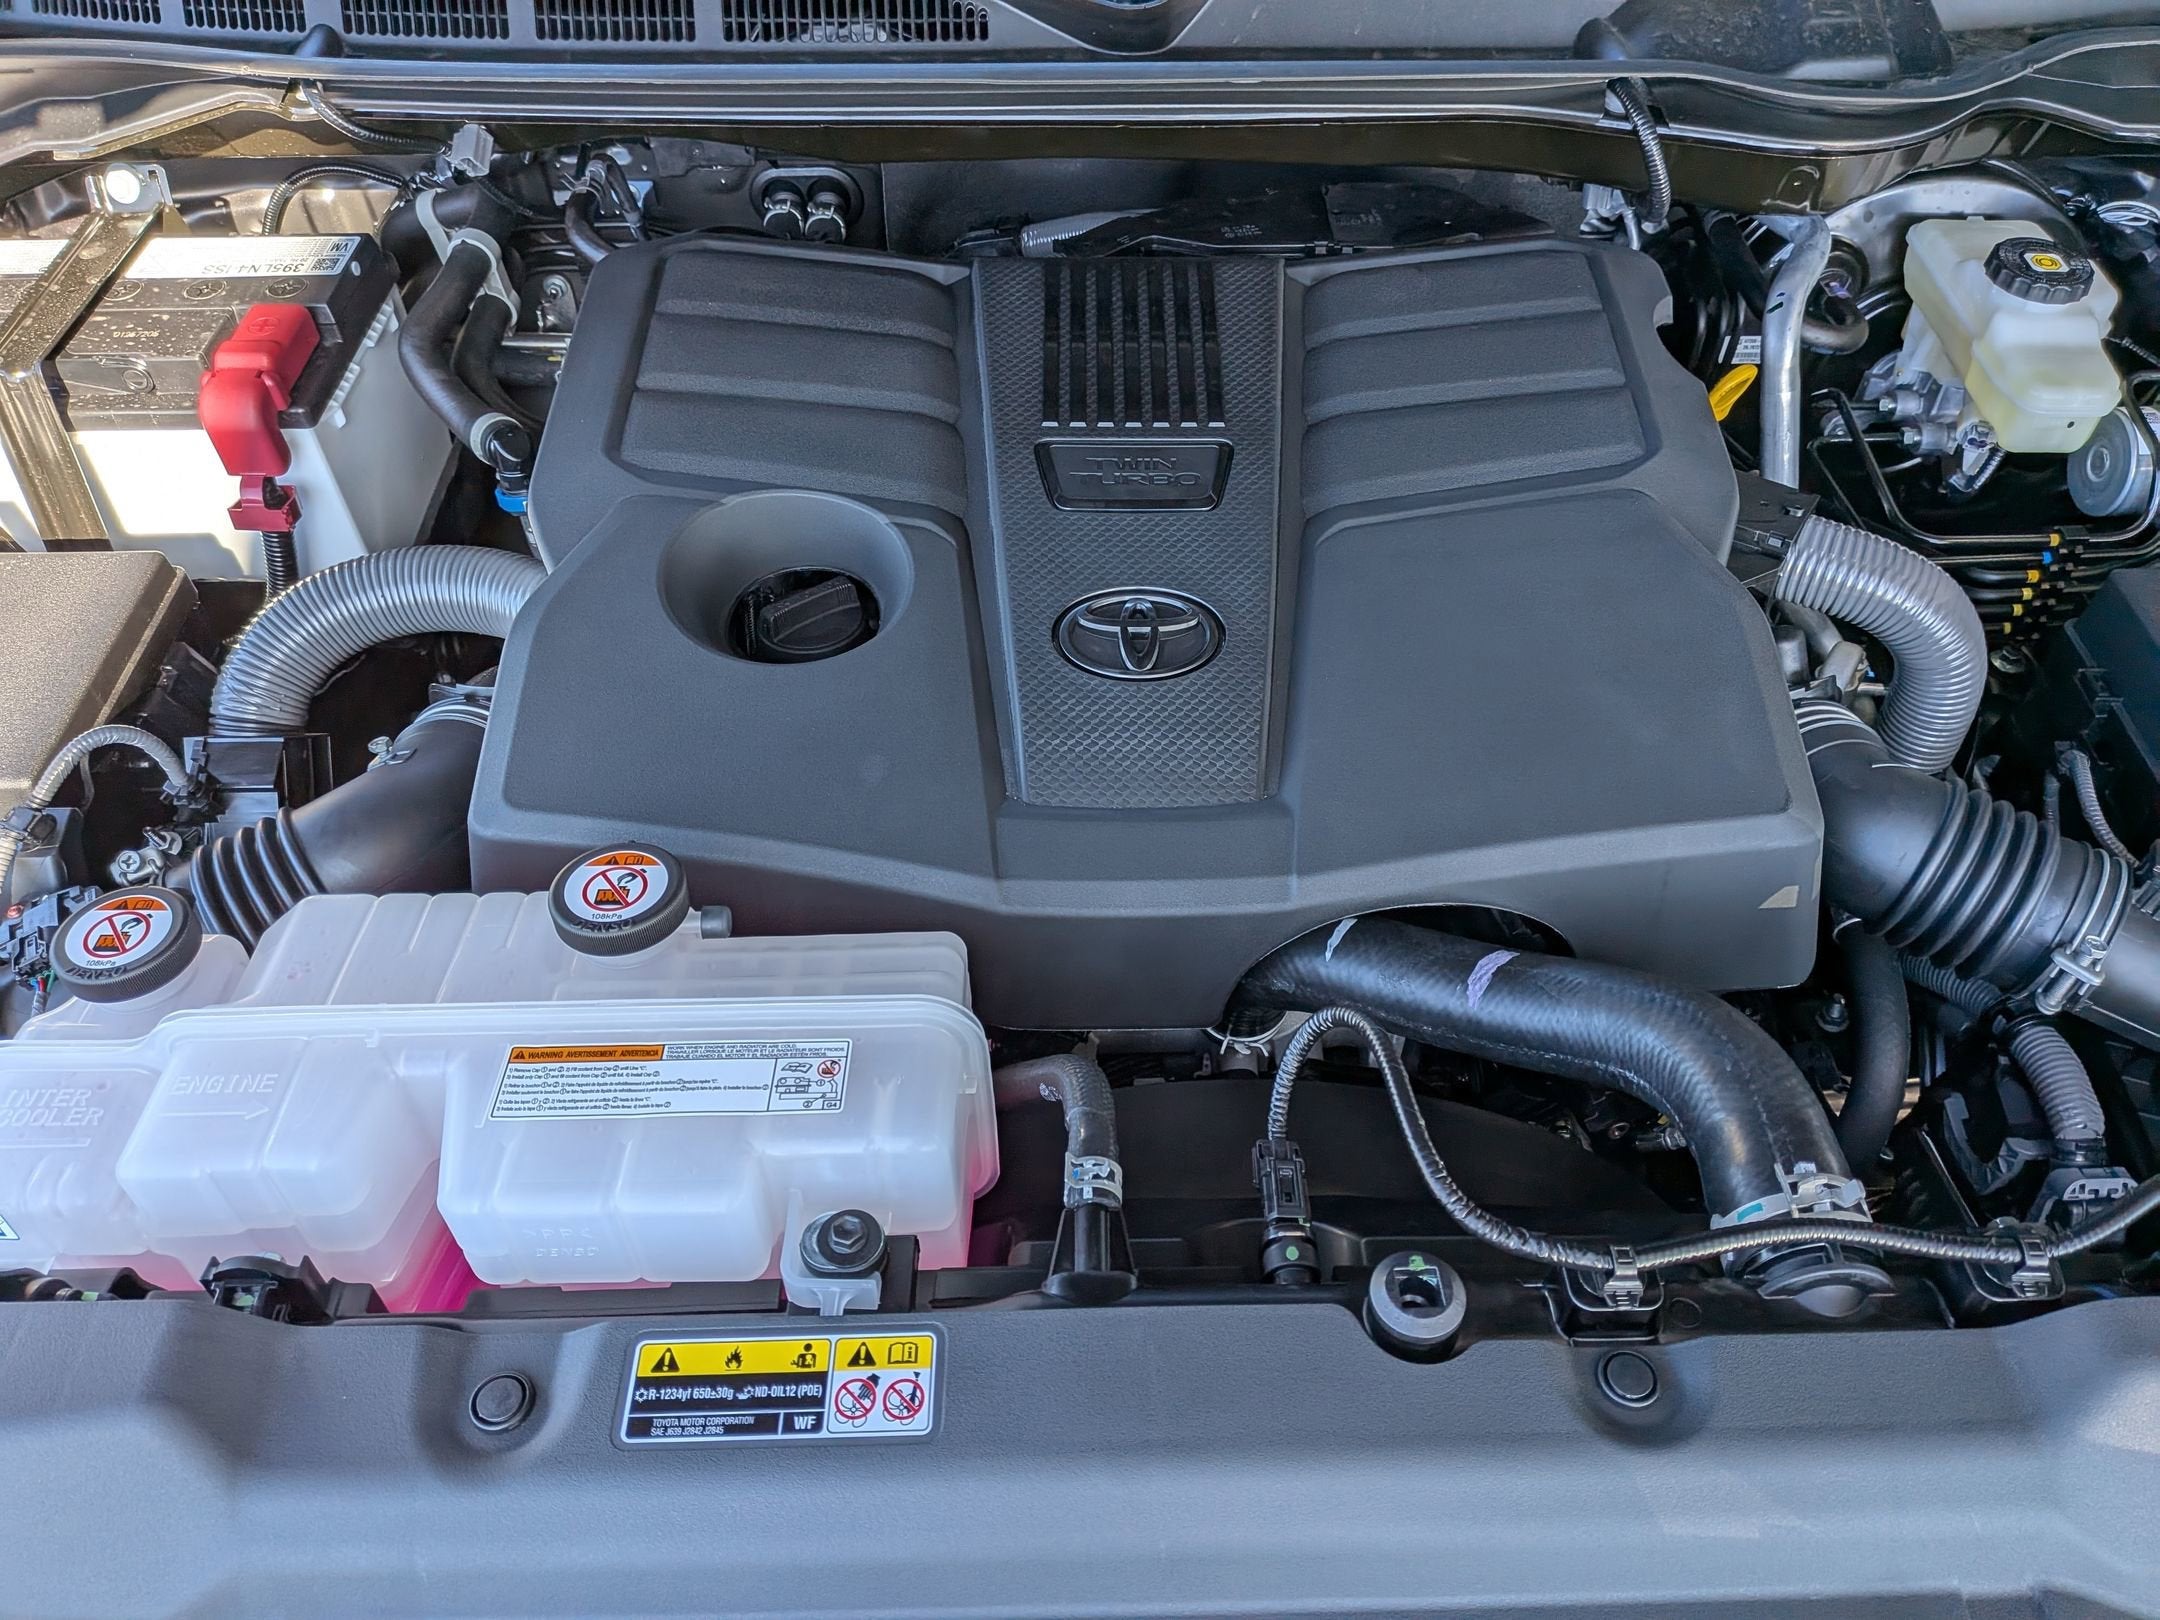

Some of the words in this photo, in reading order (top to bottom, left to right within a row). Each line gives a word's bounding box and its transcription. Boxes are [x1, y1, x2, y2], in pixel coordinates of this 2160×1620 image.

[331, 242, 349, 252] VM
[1085, 457, 1177, 471] TWIN
[1069, 472, 1201, 486] TURBO
[592, 912, 623, 920] 108kPa
[86, 959, 117, 967] 108kPa
[64, 966, 128, 980] DENSO
[528, 1051, 564, 1060] WARNING
[565, 1050, 618, 1058] AVERTISSEMENT
[619, 1049, 659, 1057] ADVERTENCIA
[167, 1073, 279, 1095] ENGINE
[0, 1088, 92, 1107] INTER
[648, 1387, 692, 1402] R-1234yf
[693, 1386, 734, 1401] 650±30g
[754, 1385, 797, 1398] ND-OIL12
[797, 1384, 823, 1399] (POE)
[653, 1418, 679, 1427] TOYOTA
[680, 1418, 705, 1426] MOTOR
[706, 1416, 755, 1426] CORPORATION
[793, 1416, 817, 1430] WF
[651, 1427, 665, 1436] SAE
[665, 1427, 682, 1436] J639
[682, 1427, 703, 1435] J2842
[703, 1426, 724, 1435] J2845
